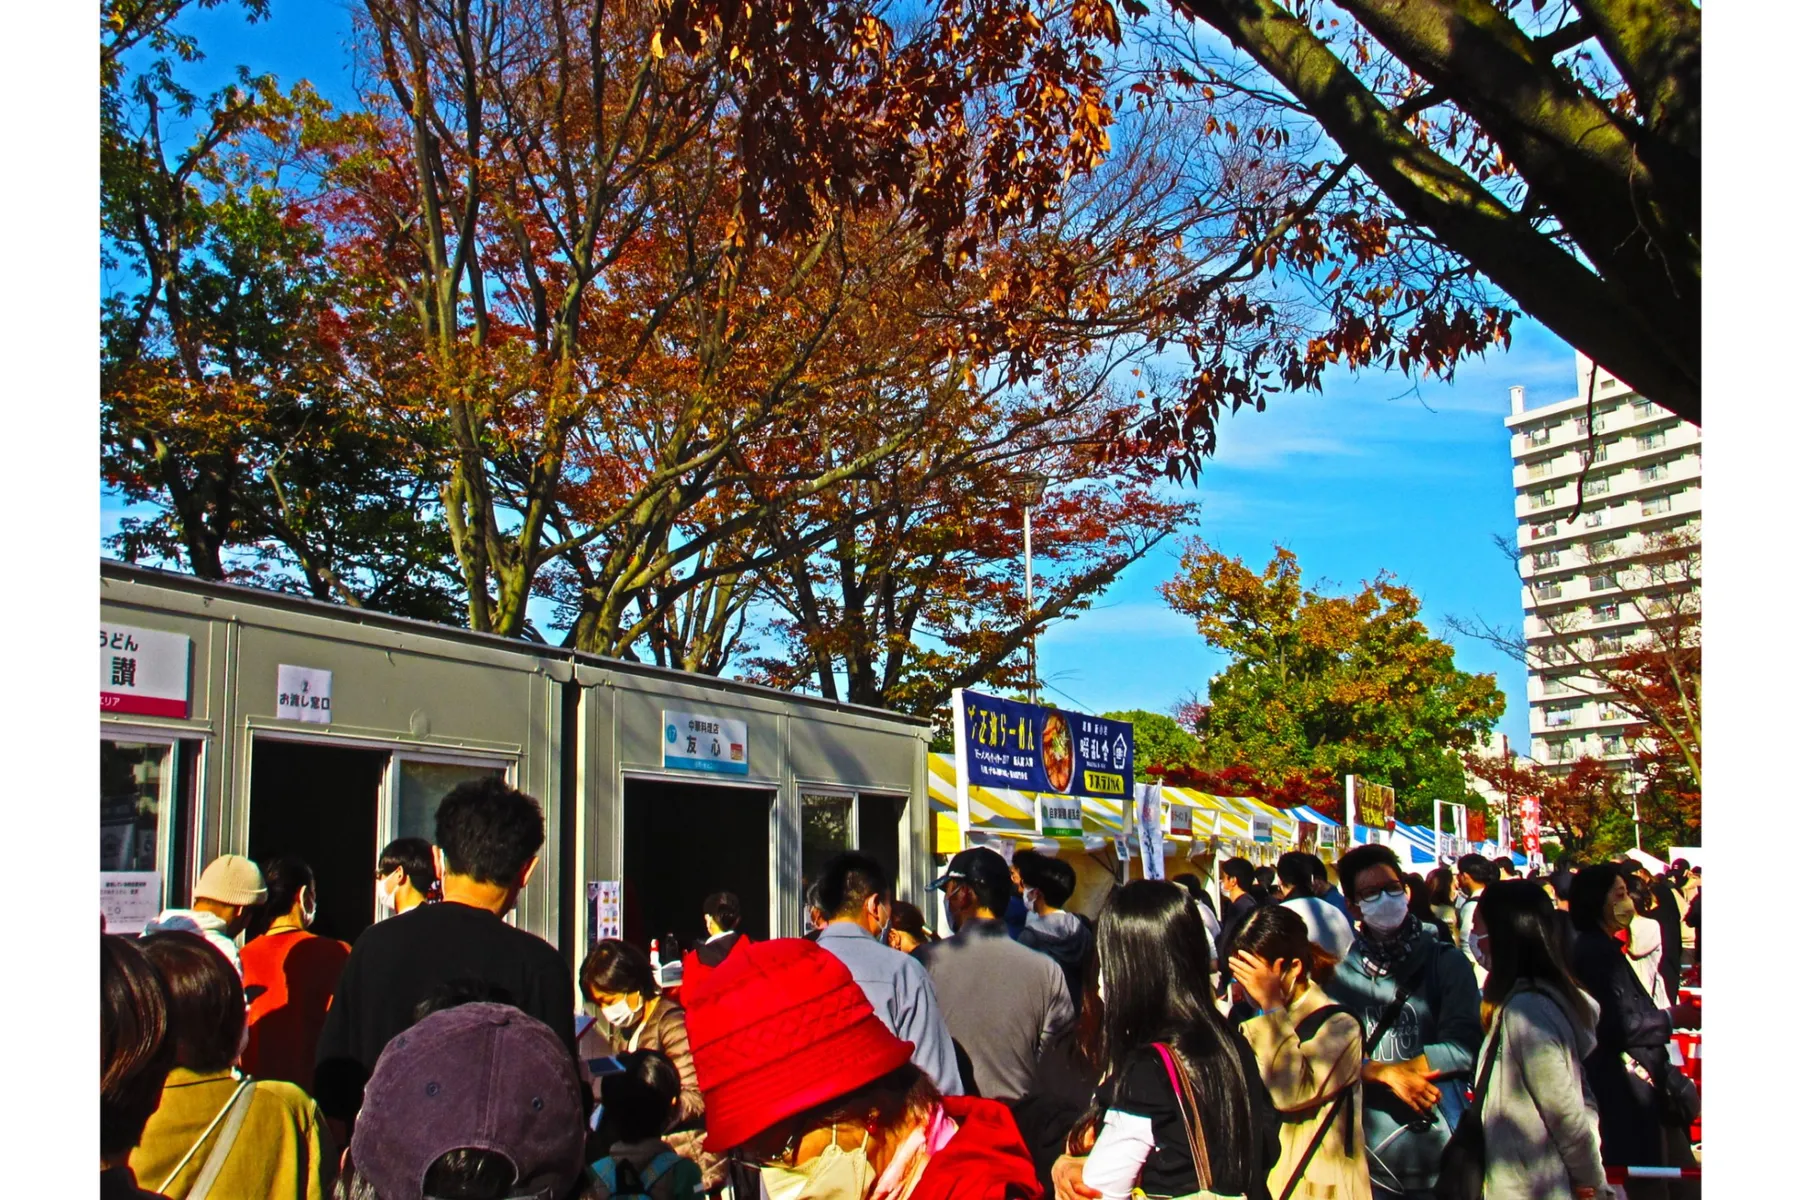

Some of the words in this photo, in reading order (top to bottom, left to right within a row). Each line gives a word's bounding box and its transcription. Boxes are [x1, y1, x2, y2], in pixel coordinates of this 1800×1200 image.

[112, 656, 136, 687] 讃
[279, 693, 330, 710] お渡し窓口
[688, 720, 720, 735] 中華料理店
